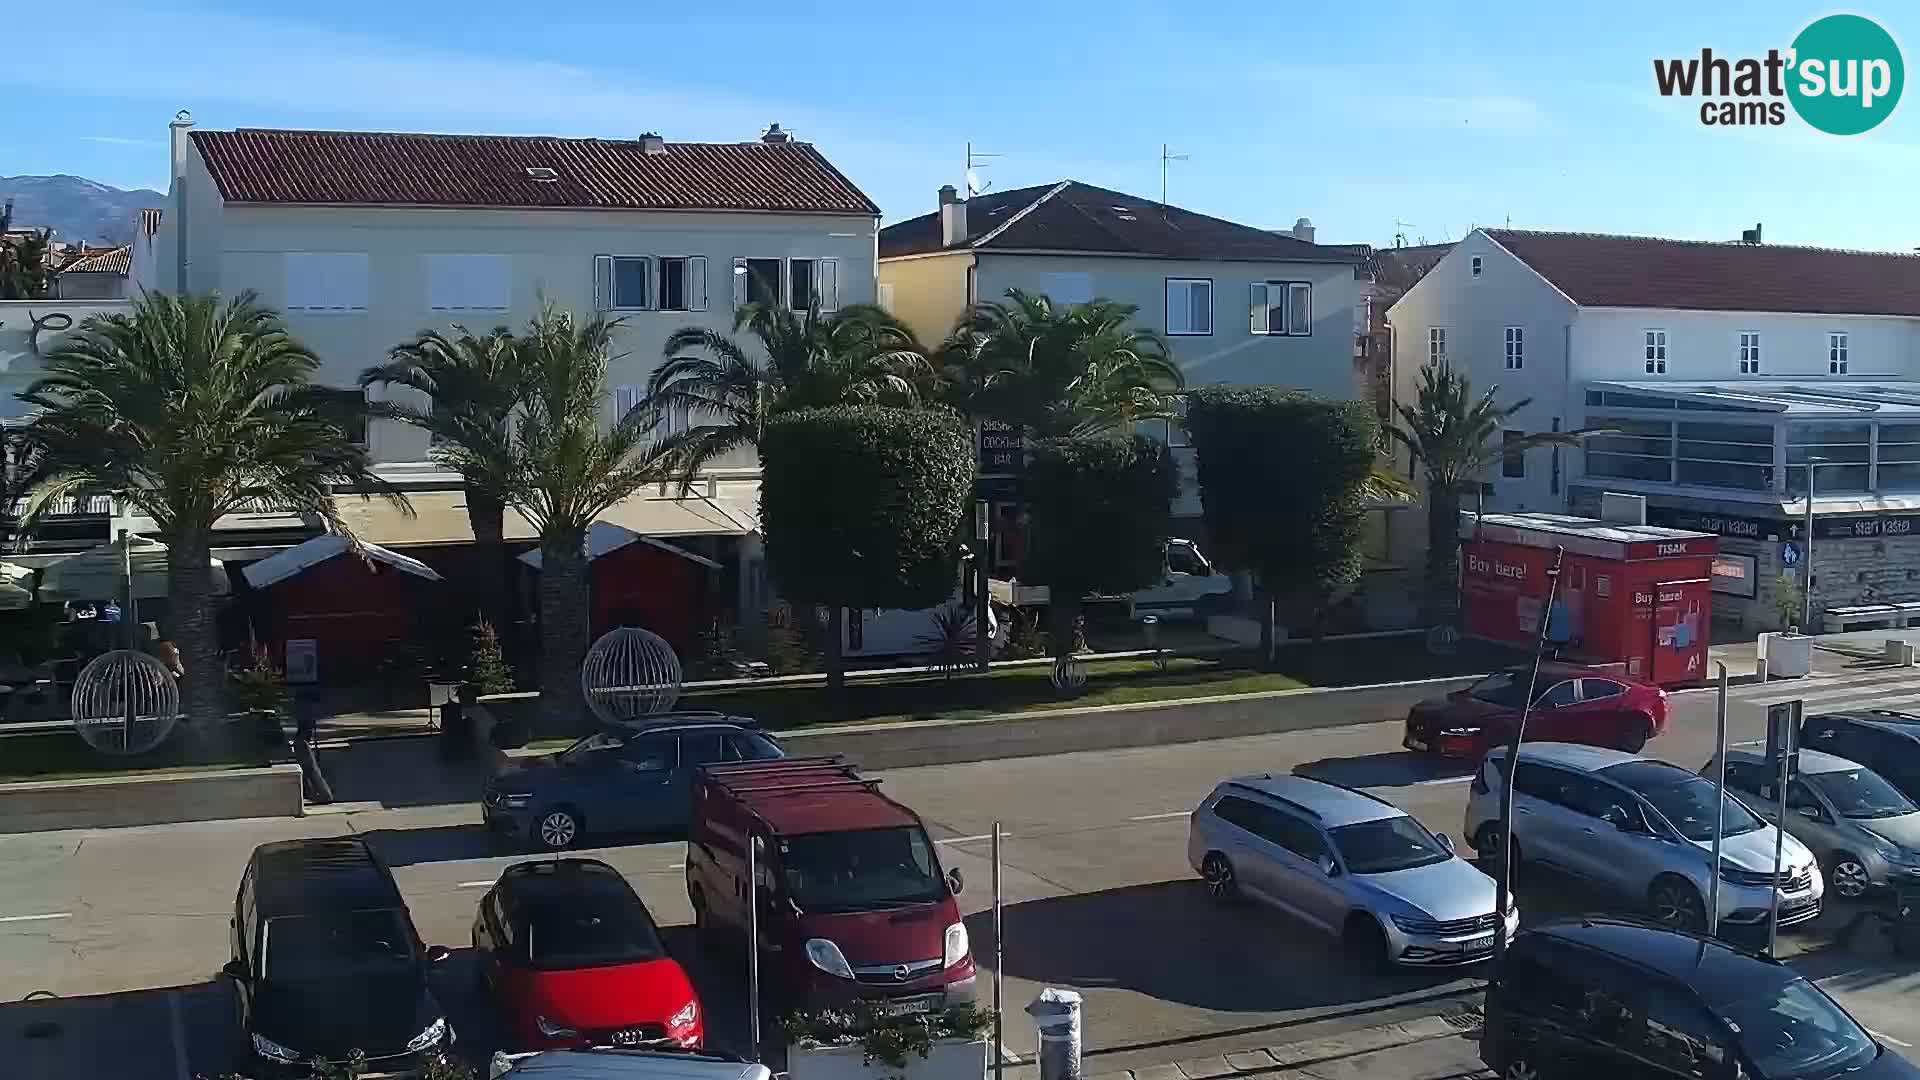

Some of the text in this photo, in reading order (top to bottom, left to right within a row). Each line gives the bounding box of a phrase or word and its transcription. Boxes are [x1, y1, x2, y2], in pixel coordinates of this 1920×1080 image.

[994, 453, 1013, 465] BAR
[1656, 543, 1687, 555] TISAK
[1635, 592, 1653, 604] Buy
